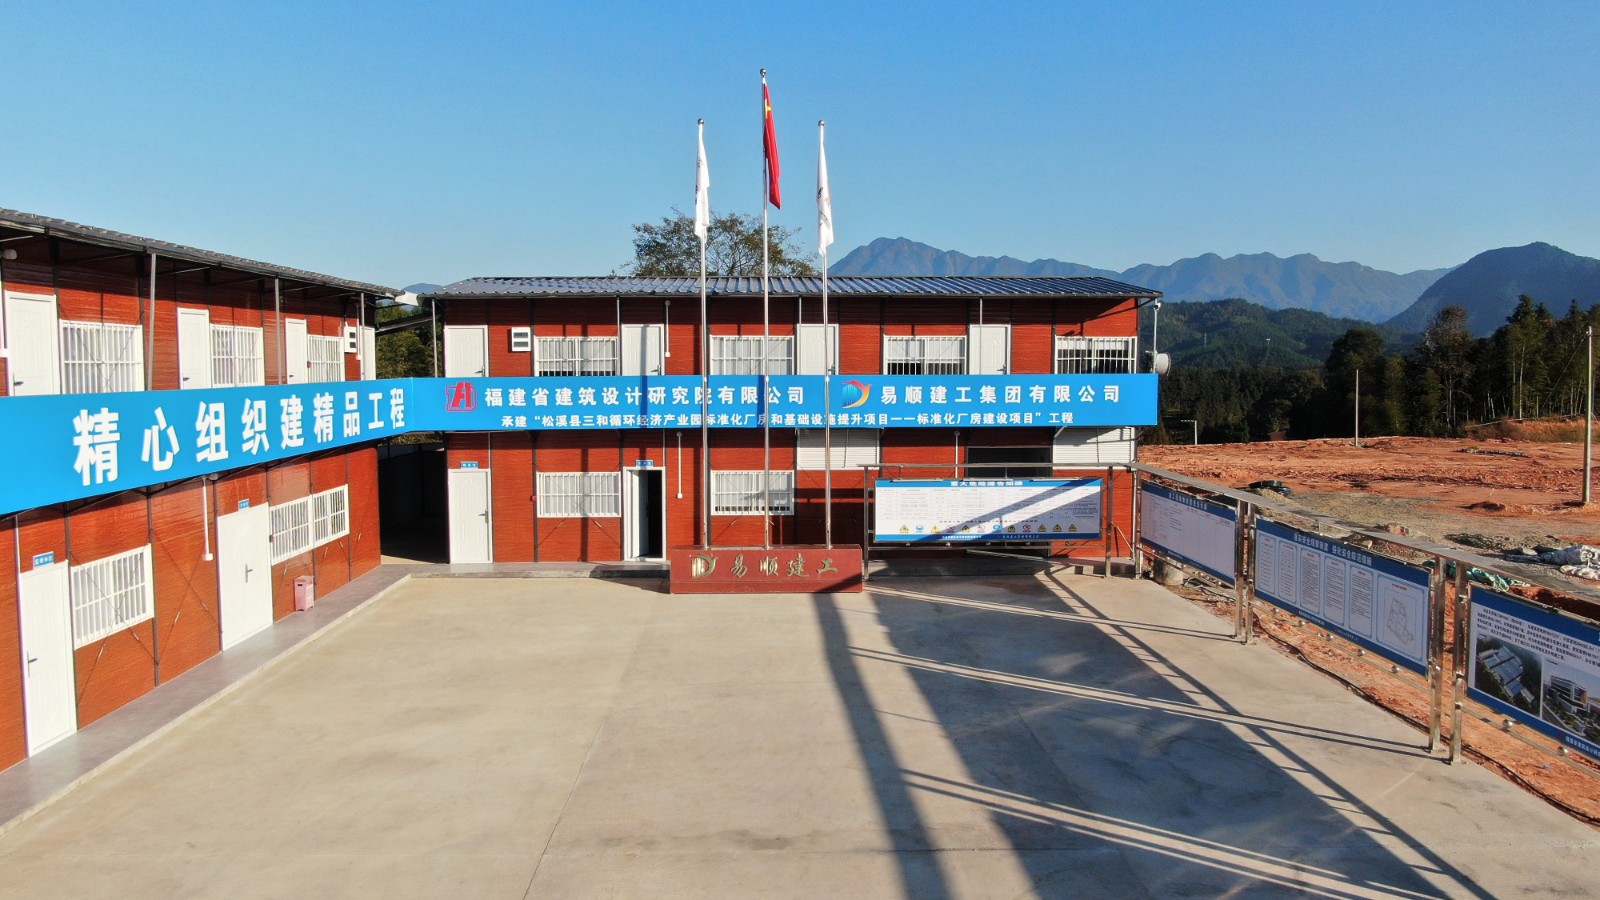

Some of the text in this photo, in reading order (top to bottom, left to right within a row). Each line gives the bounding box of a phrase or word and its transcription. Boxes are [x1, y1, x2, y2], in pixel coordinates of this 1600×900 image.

[485, 386, 804, 407] 福建省建筑设计研究院有限公司
[881, 385, 1120, 405] 易顺建工集团有限公司
[73, 388, 406, 487] 精心组织建精品工程
[730, 553, 838, 578] 易顺建工
